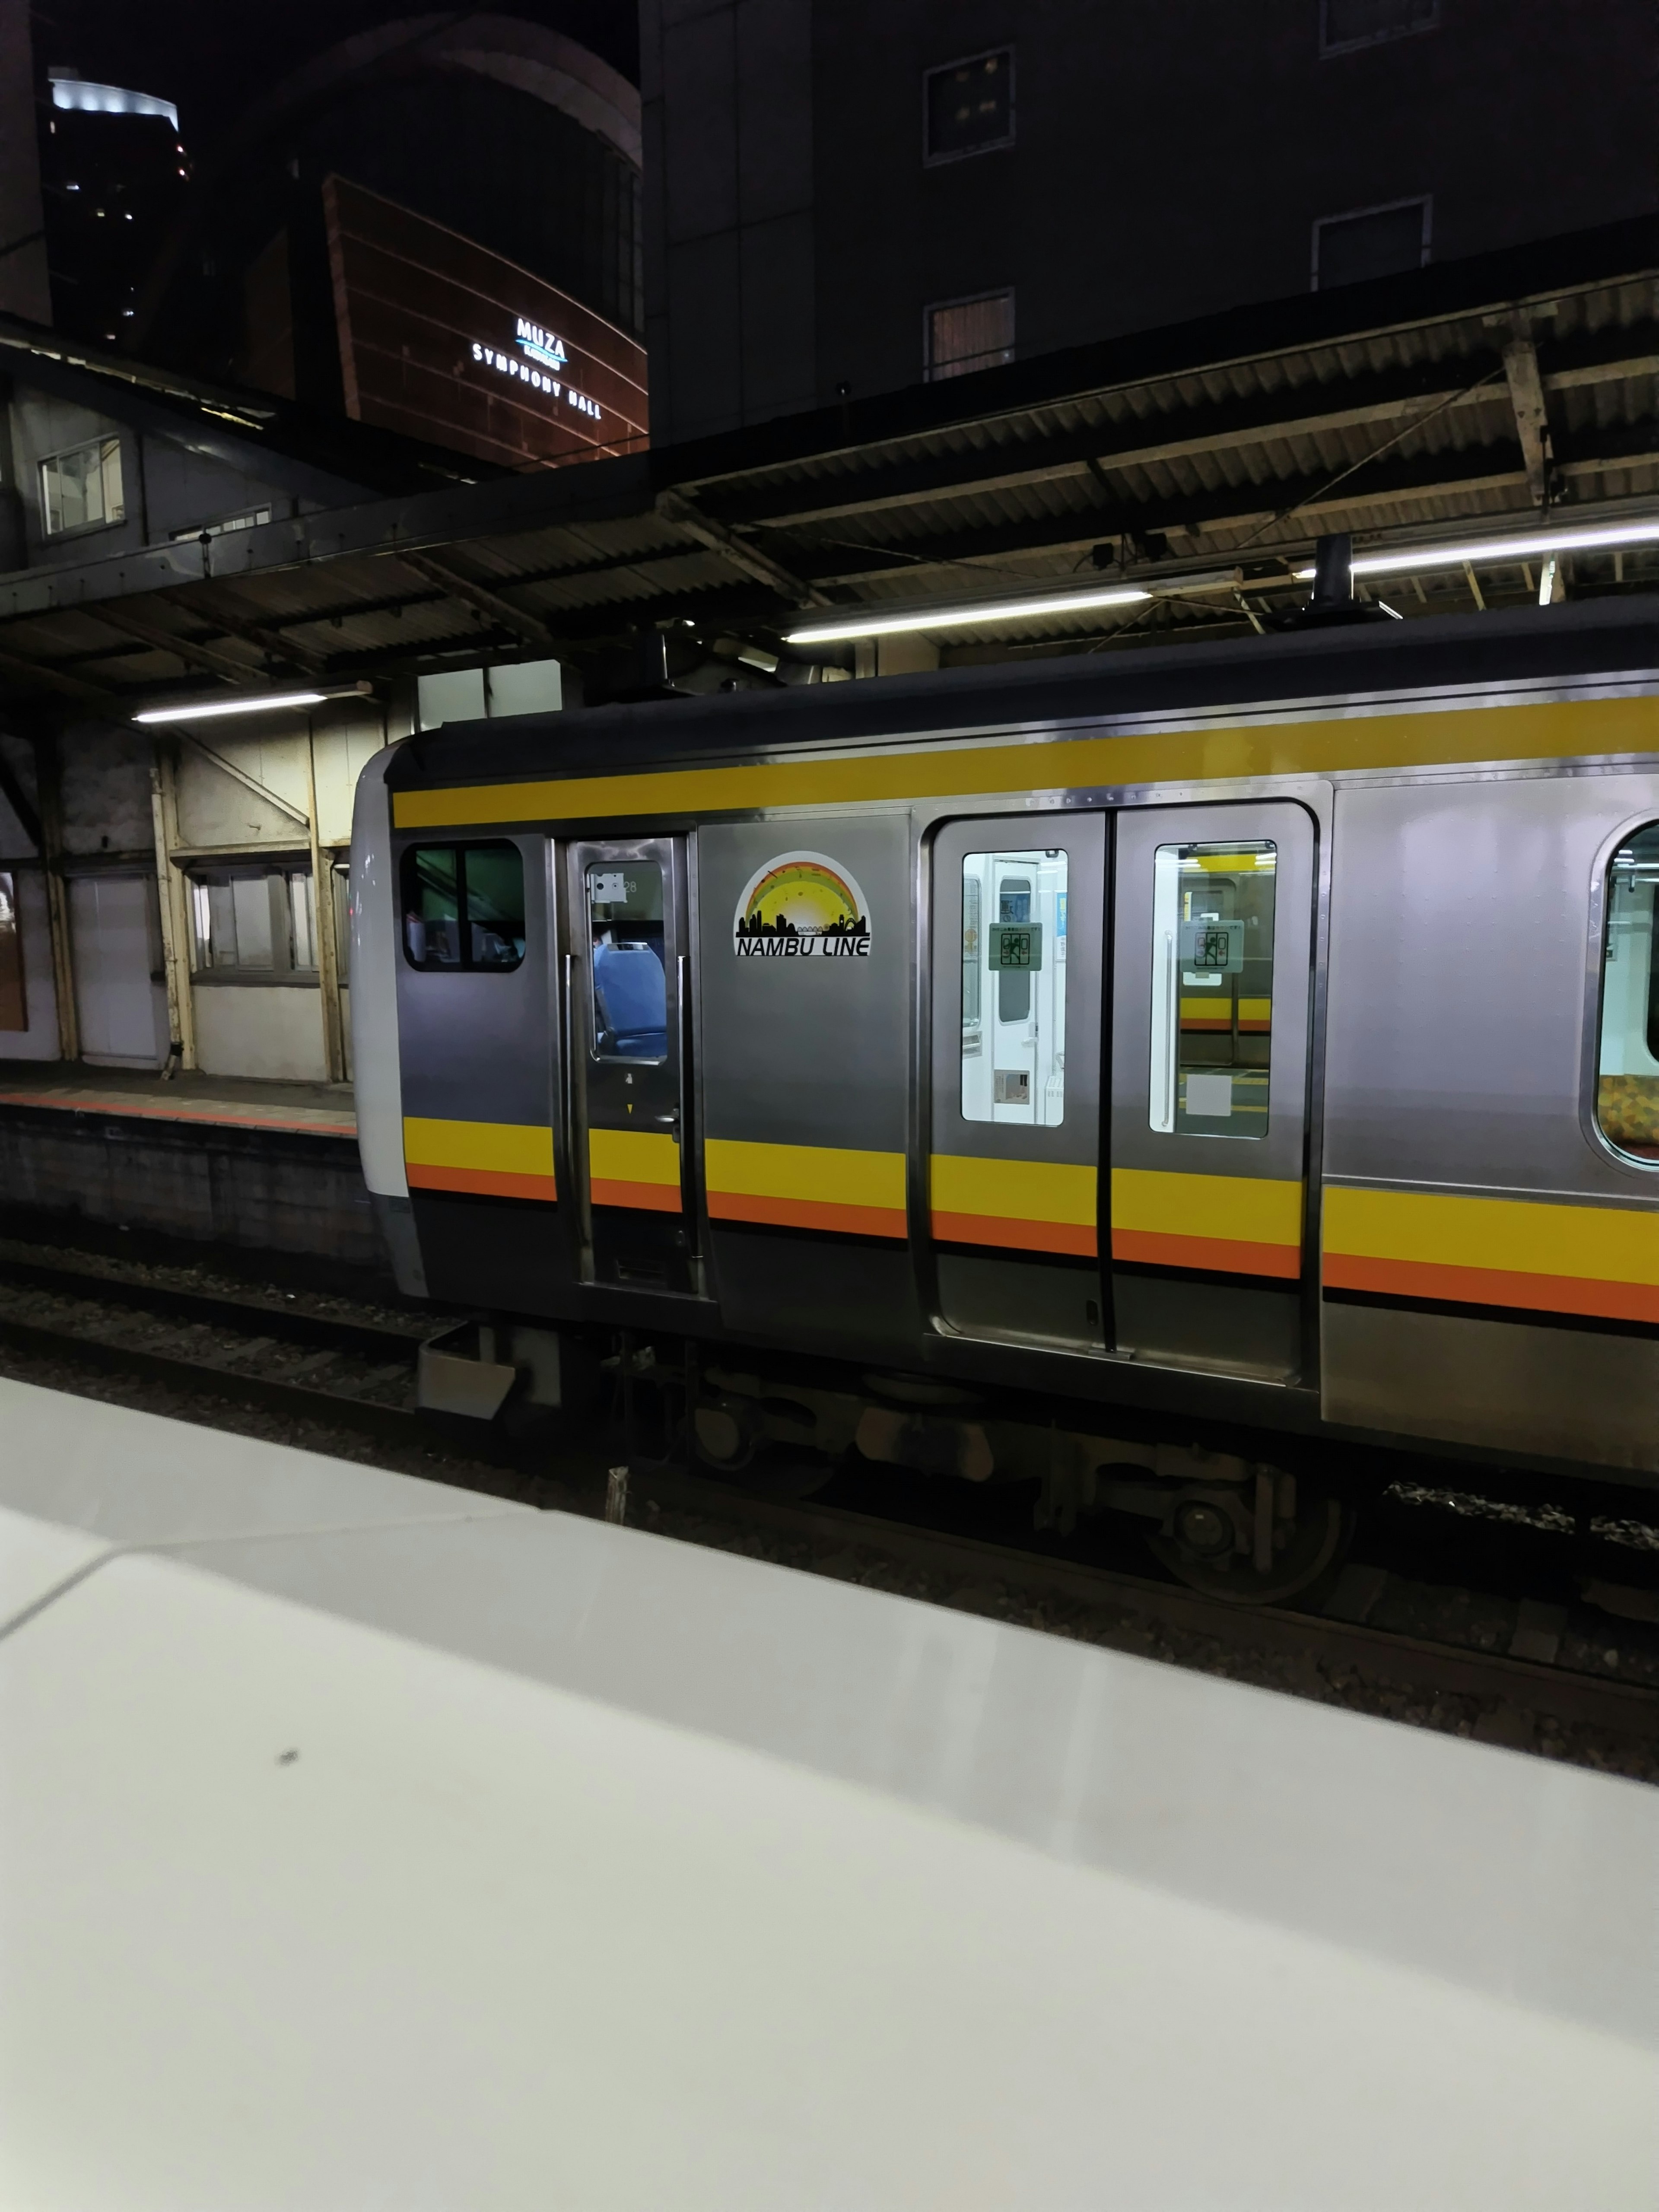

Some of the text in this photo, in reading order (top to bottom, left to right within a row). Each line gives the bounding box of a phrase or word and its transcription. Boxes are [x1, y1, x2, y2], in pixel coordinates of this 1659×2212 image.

[517, 318, 565, 359] MUZA
[473, 343, 561, 397] SYMPHONY
[569, 390, 601, 420] HALL
[737, 938, 870, 956] NAMBU LINE
